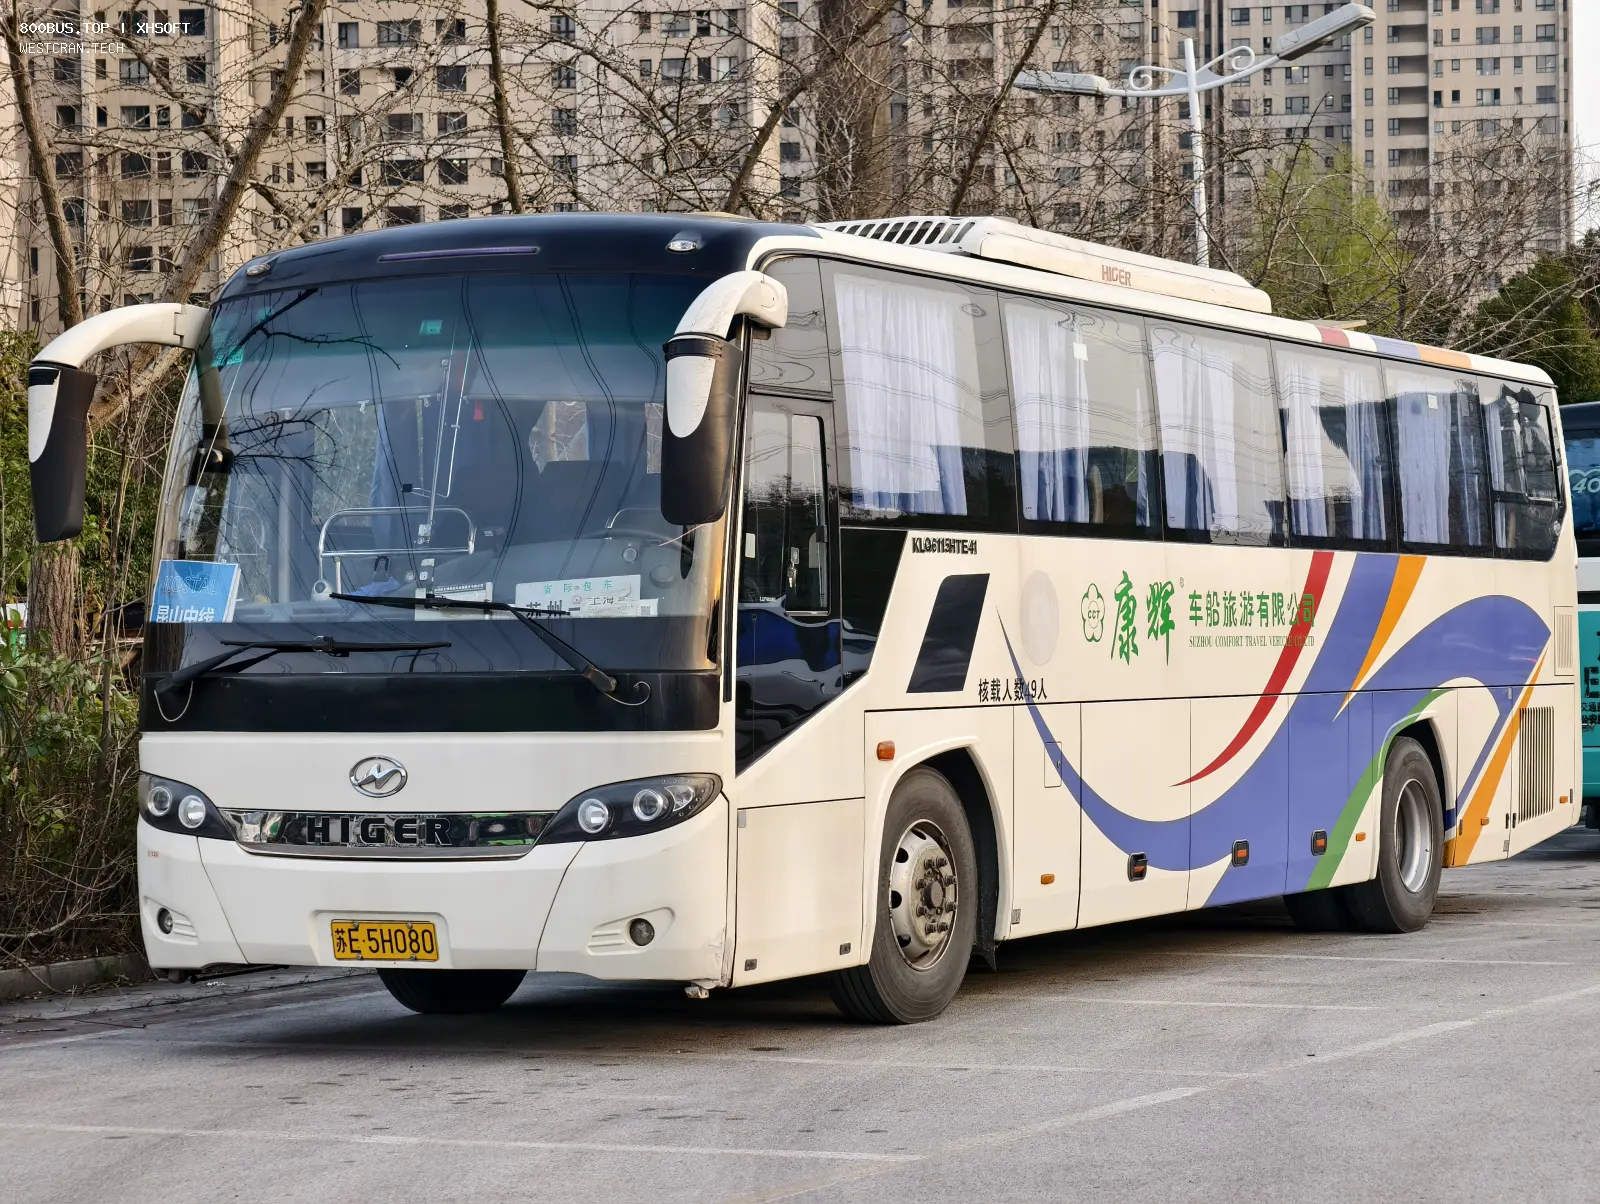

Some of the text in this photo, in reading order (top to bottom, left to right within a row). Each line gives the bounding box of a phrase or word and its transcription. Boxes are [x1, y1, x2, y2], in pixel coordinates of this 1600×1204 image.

[1101, 264, 1132, 287] HIGER
[163, 575, 218, 596] KOSTAL
[155, 604, 215, 623] 昆山中线
[1087, 609, 1101, 619] CCT
[1188, 589, 1316, 628] 车船旅游有限公司
[1189, 635, 1212, 648] SUZHOU
[1214, 635, 1243, 647] COMFORT
[1245, 635, 1267, 647] TRAVEL
[1269, 635, 1292, 647] VEHICLE
[978, 677, 1048, 703] 核载人数49人
[305, 815, 453, 847] HIGER
